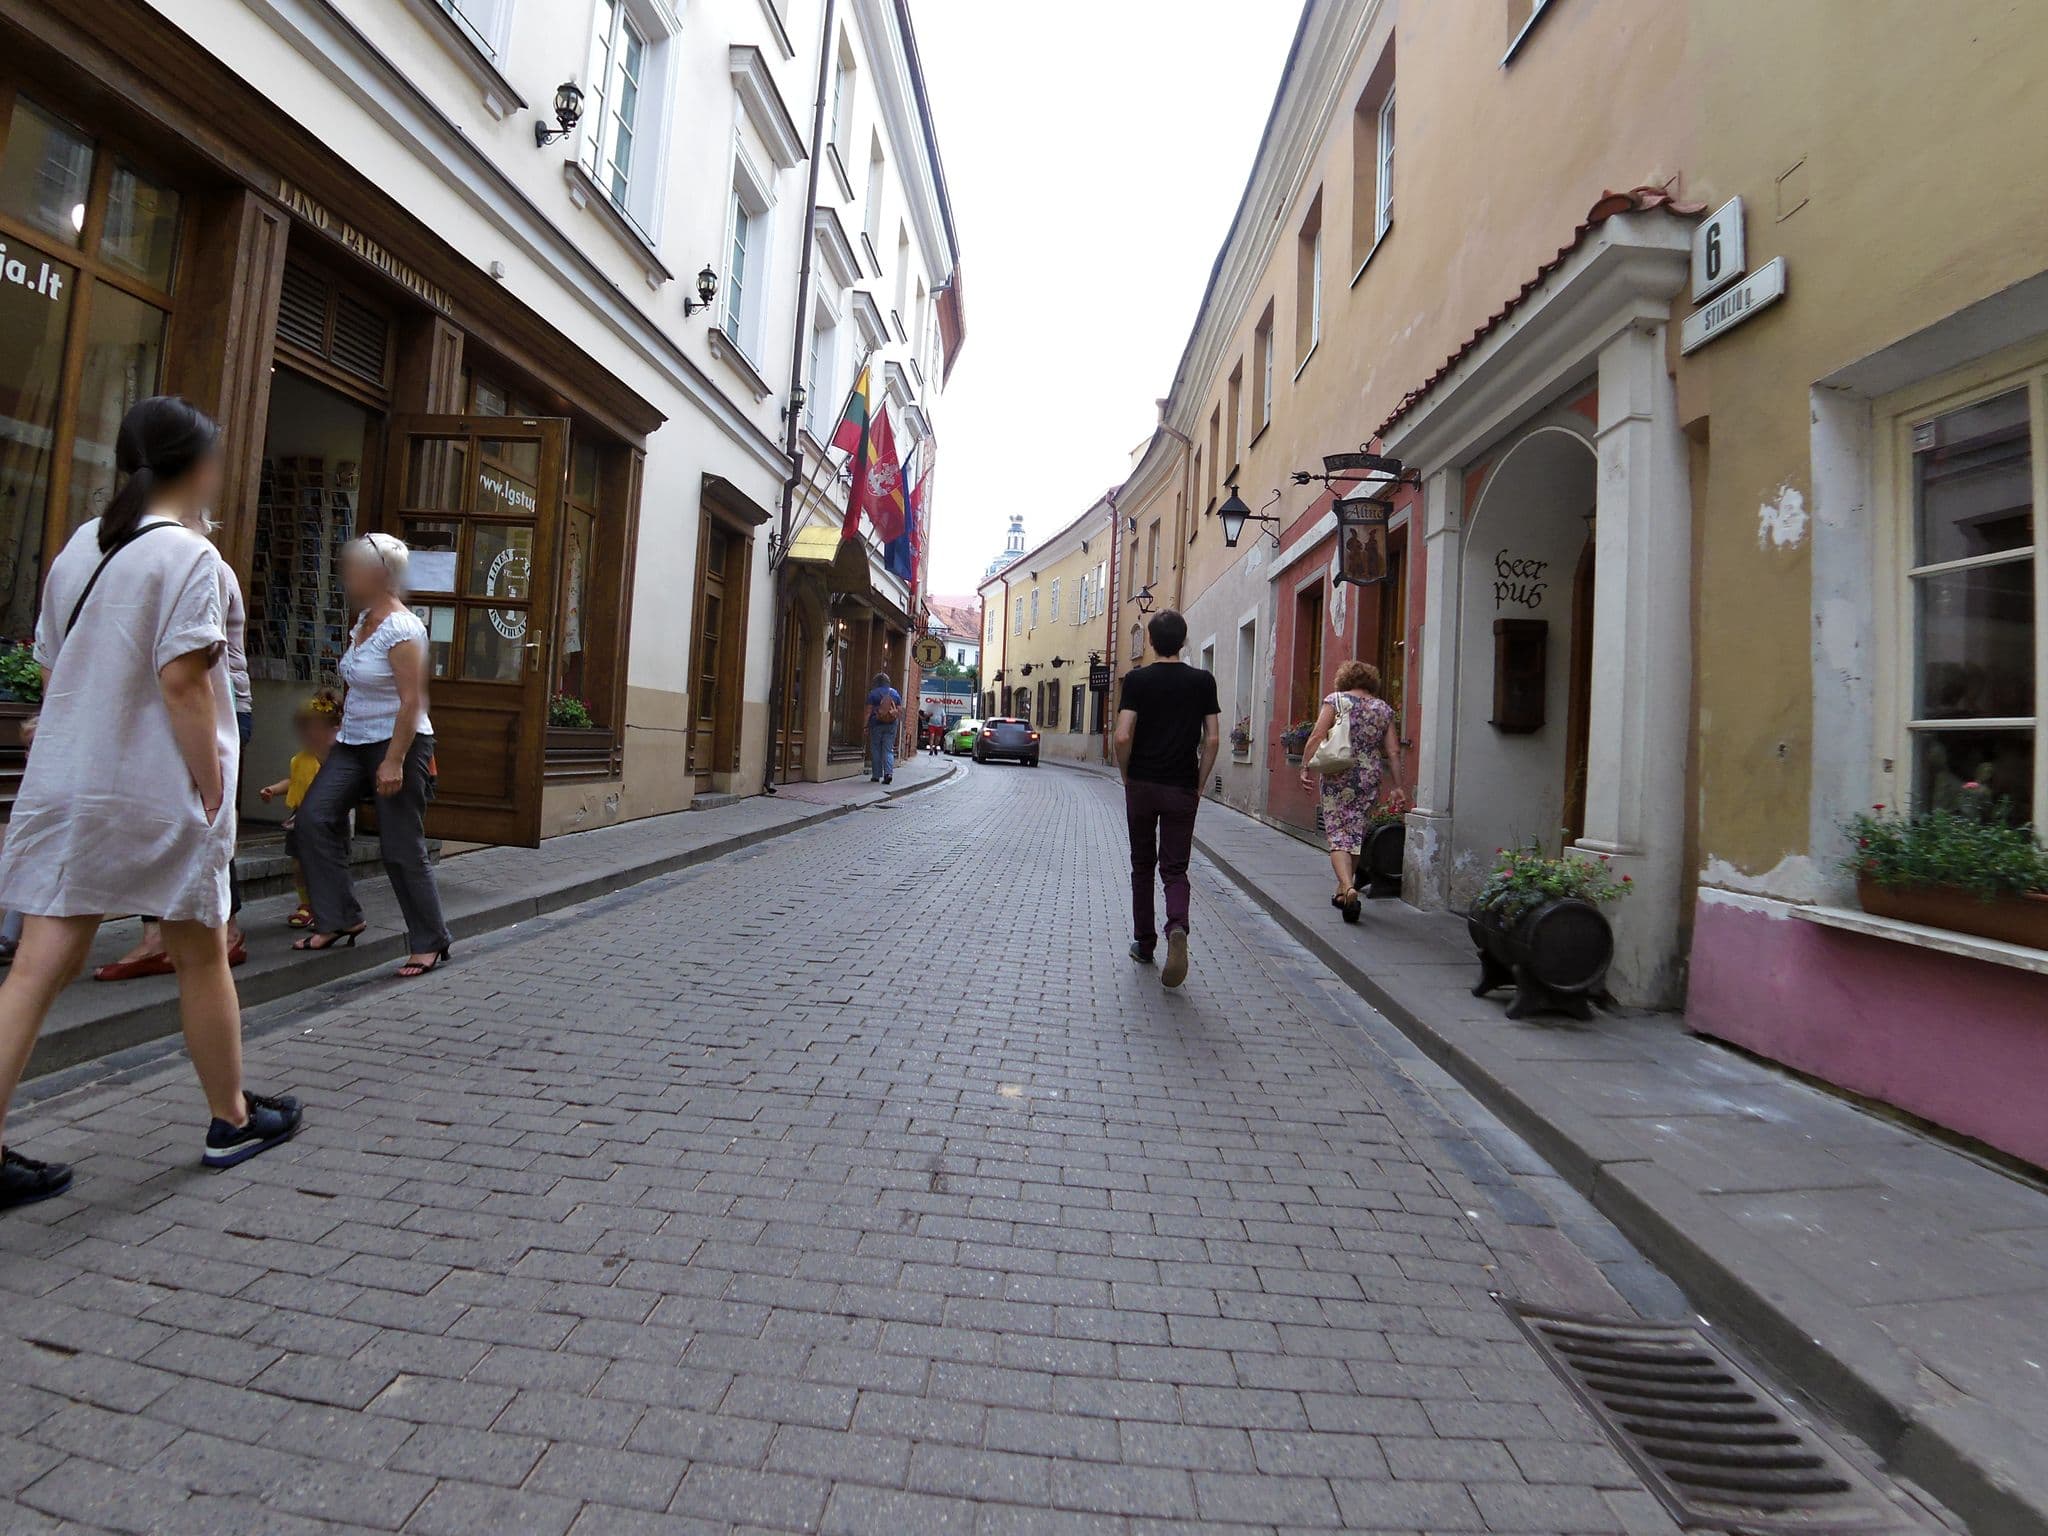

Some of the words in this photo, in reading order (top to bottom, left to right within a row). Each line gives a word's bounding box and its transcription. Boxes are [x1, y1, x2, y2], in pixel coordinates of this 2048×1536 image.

[278, 177, 330, 230] LINO
[1705, 221, 1721, 281] 6
[1495, 549, 1548, 580] beer
[1493, 581, 1548, 610] pub
